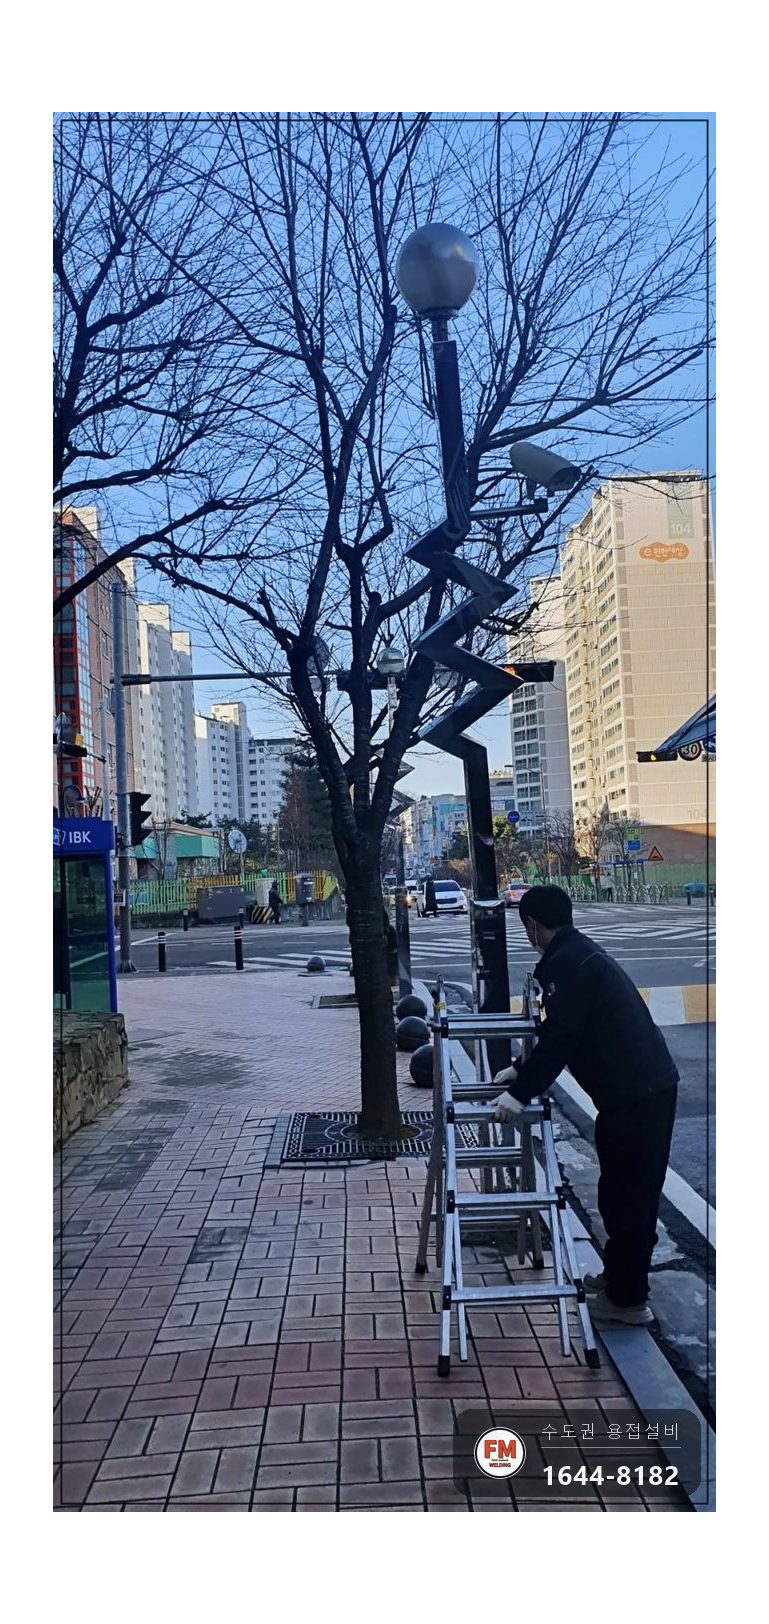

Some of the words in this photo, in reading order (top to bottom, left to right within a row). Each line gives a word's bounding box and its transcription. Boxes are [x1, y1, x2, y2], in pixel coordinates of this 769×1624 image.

[670, 523, 691, 534] 104
[682, 744, 698, 755] 30
[69, 831, 92, 844] IBK
